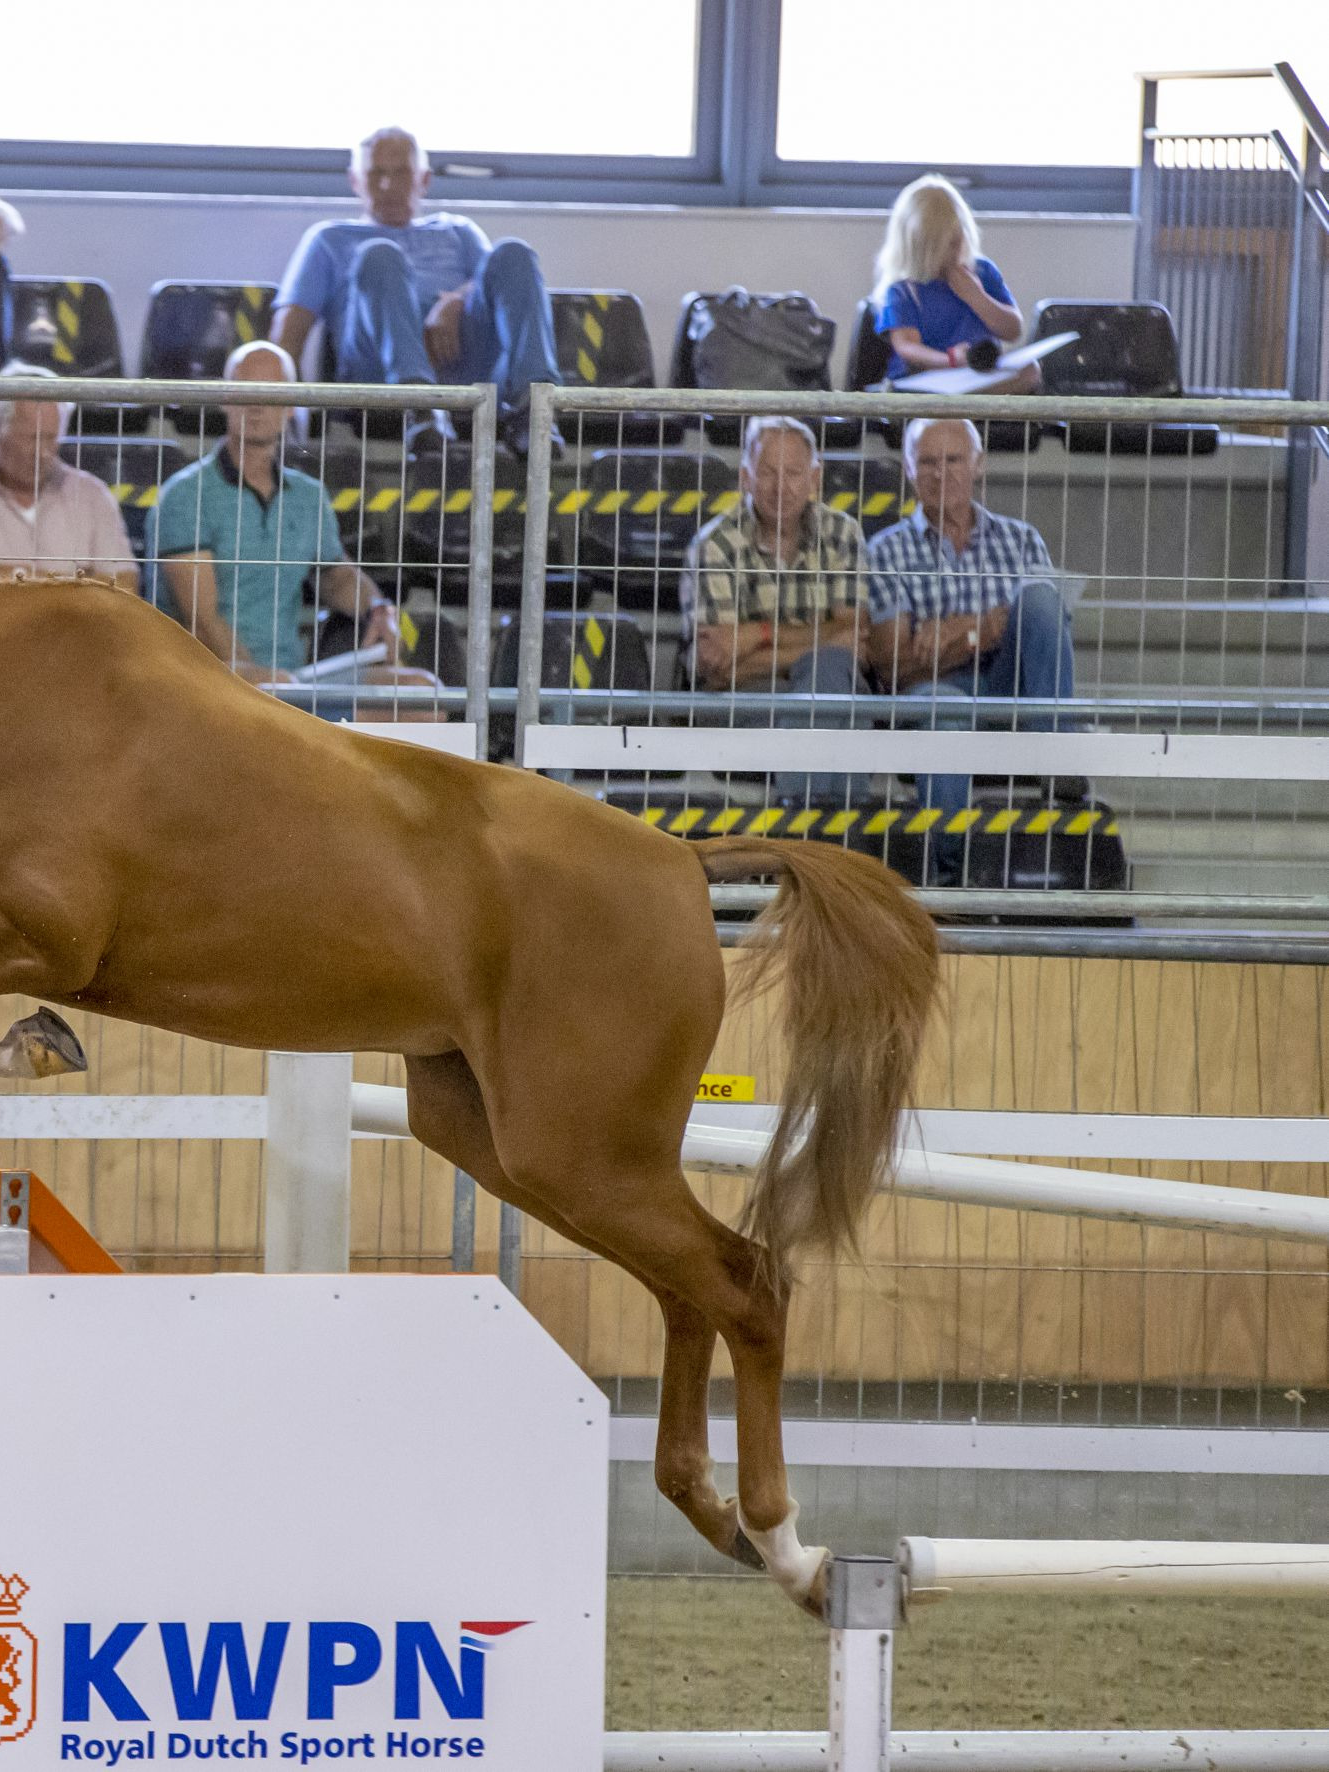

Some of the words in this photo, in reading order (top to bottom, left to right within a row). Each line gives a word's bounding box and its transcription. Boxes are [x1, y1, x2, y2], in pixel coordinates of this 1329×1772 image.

[61, 1620, 486, 1722] KWPN
[60, 1731, 156, 1767] Royal
[167, 1729, 268, 1759] Dutch
[280, 1731, 376, 1765] Sport
[386, 1731, 485, 1758] Horse
